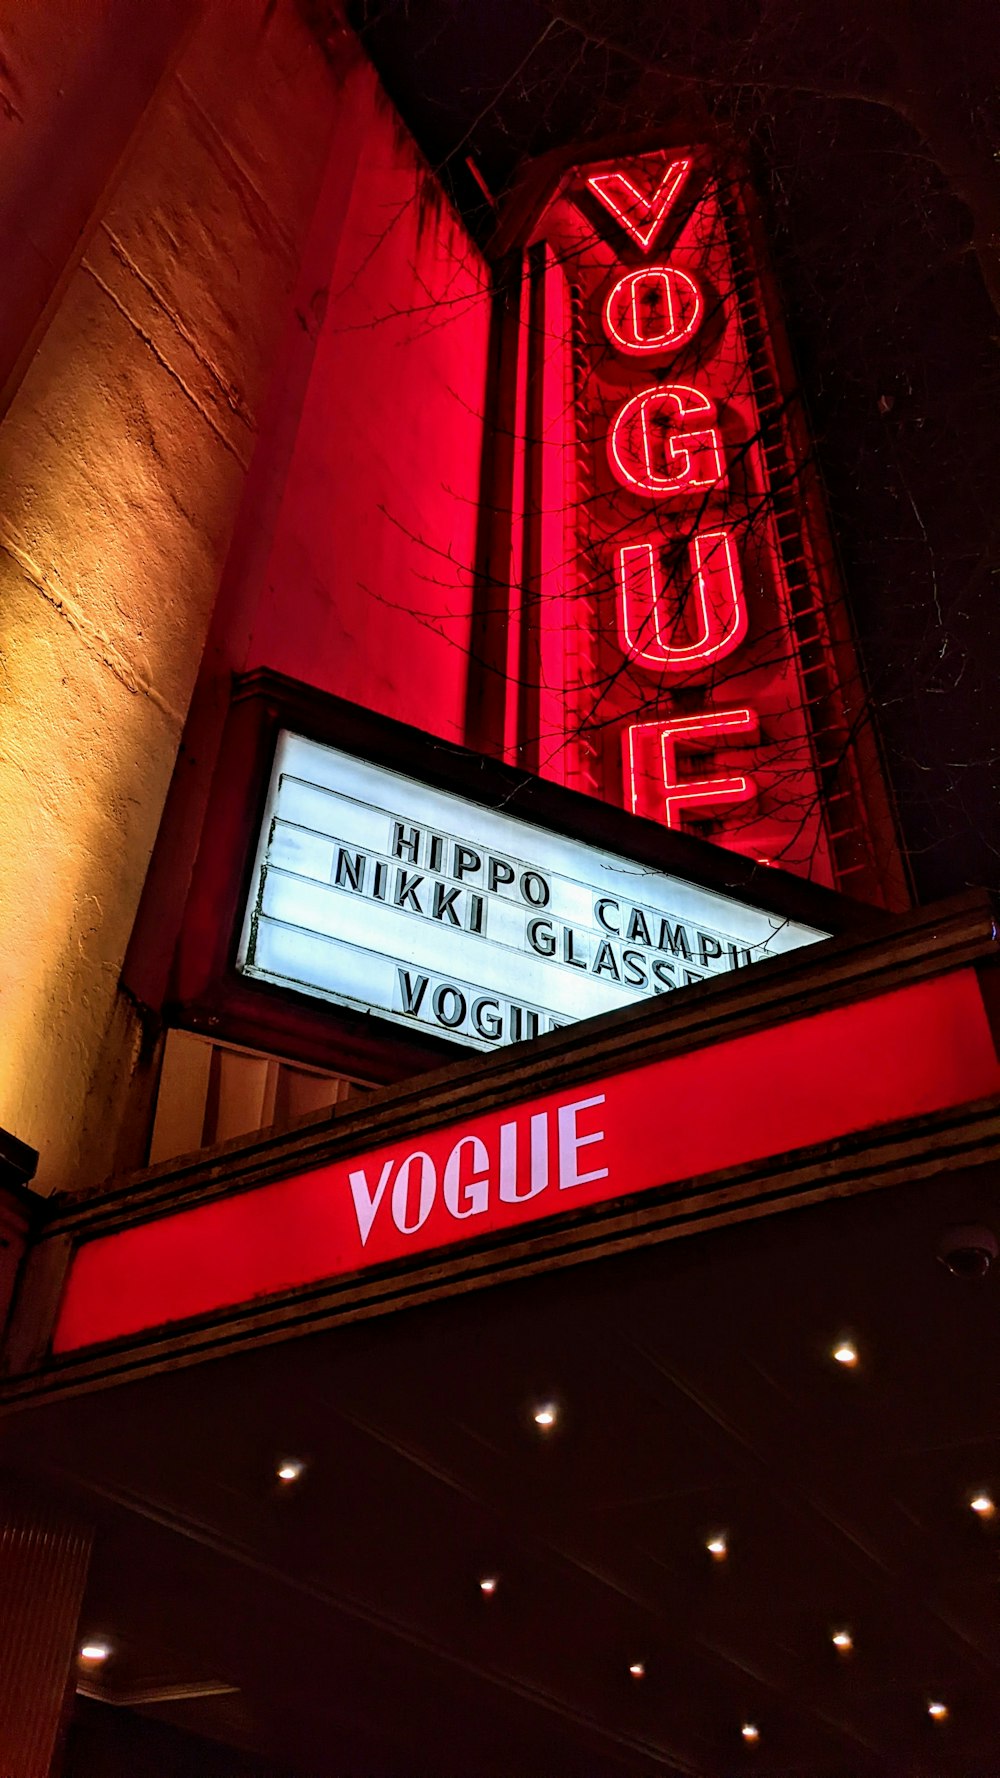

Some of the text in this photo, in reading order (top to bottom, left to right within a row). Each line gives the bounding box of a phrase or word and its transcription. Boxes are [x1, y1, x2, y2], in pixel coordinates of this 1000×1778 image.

[584, 156, 770, 866] VOGUE
[335, 847, 484, 934] NIKKI
[392, 821, 778, 970] HIPPO CAMPU
[397, 968, 570, 1044] VOGU
[348, 1094, 609, 1247] VOGUE
